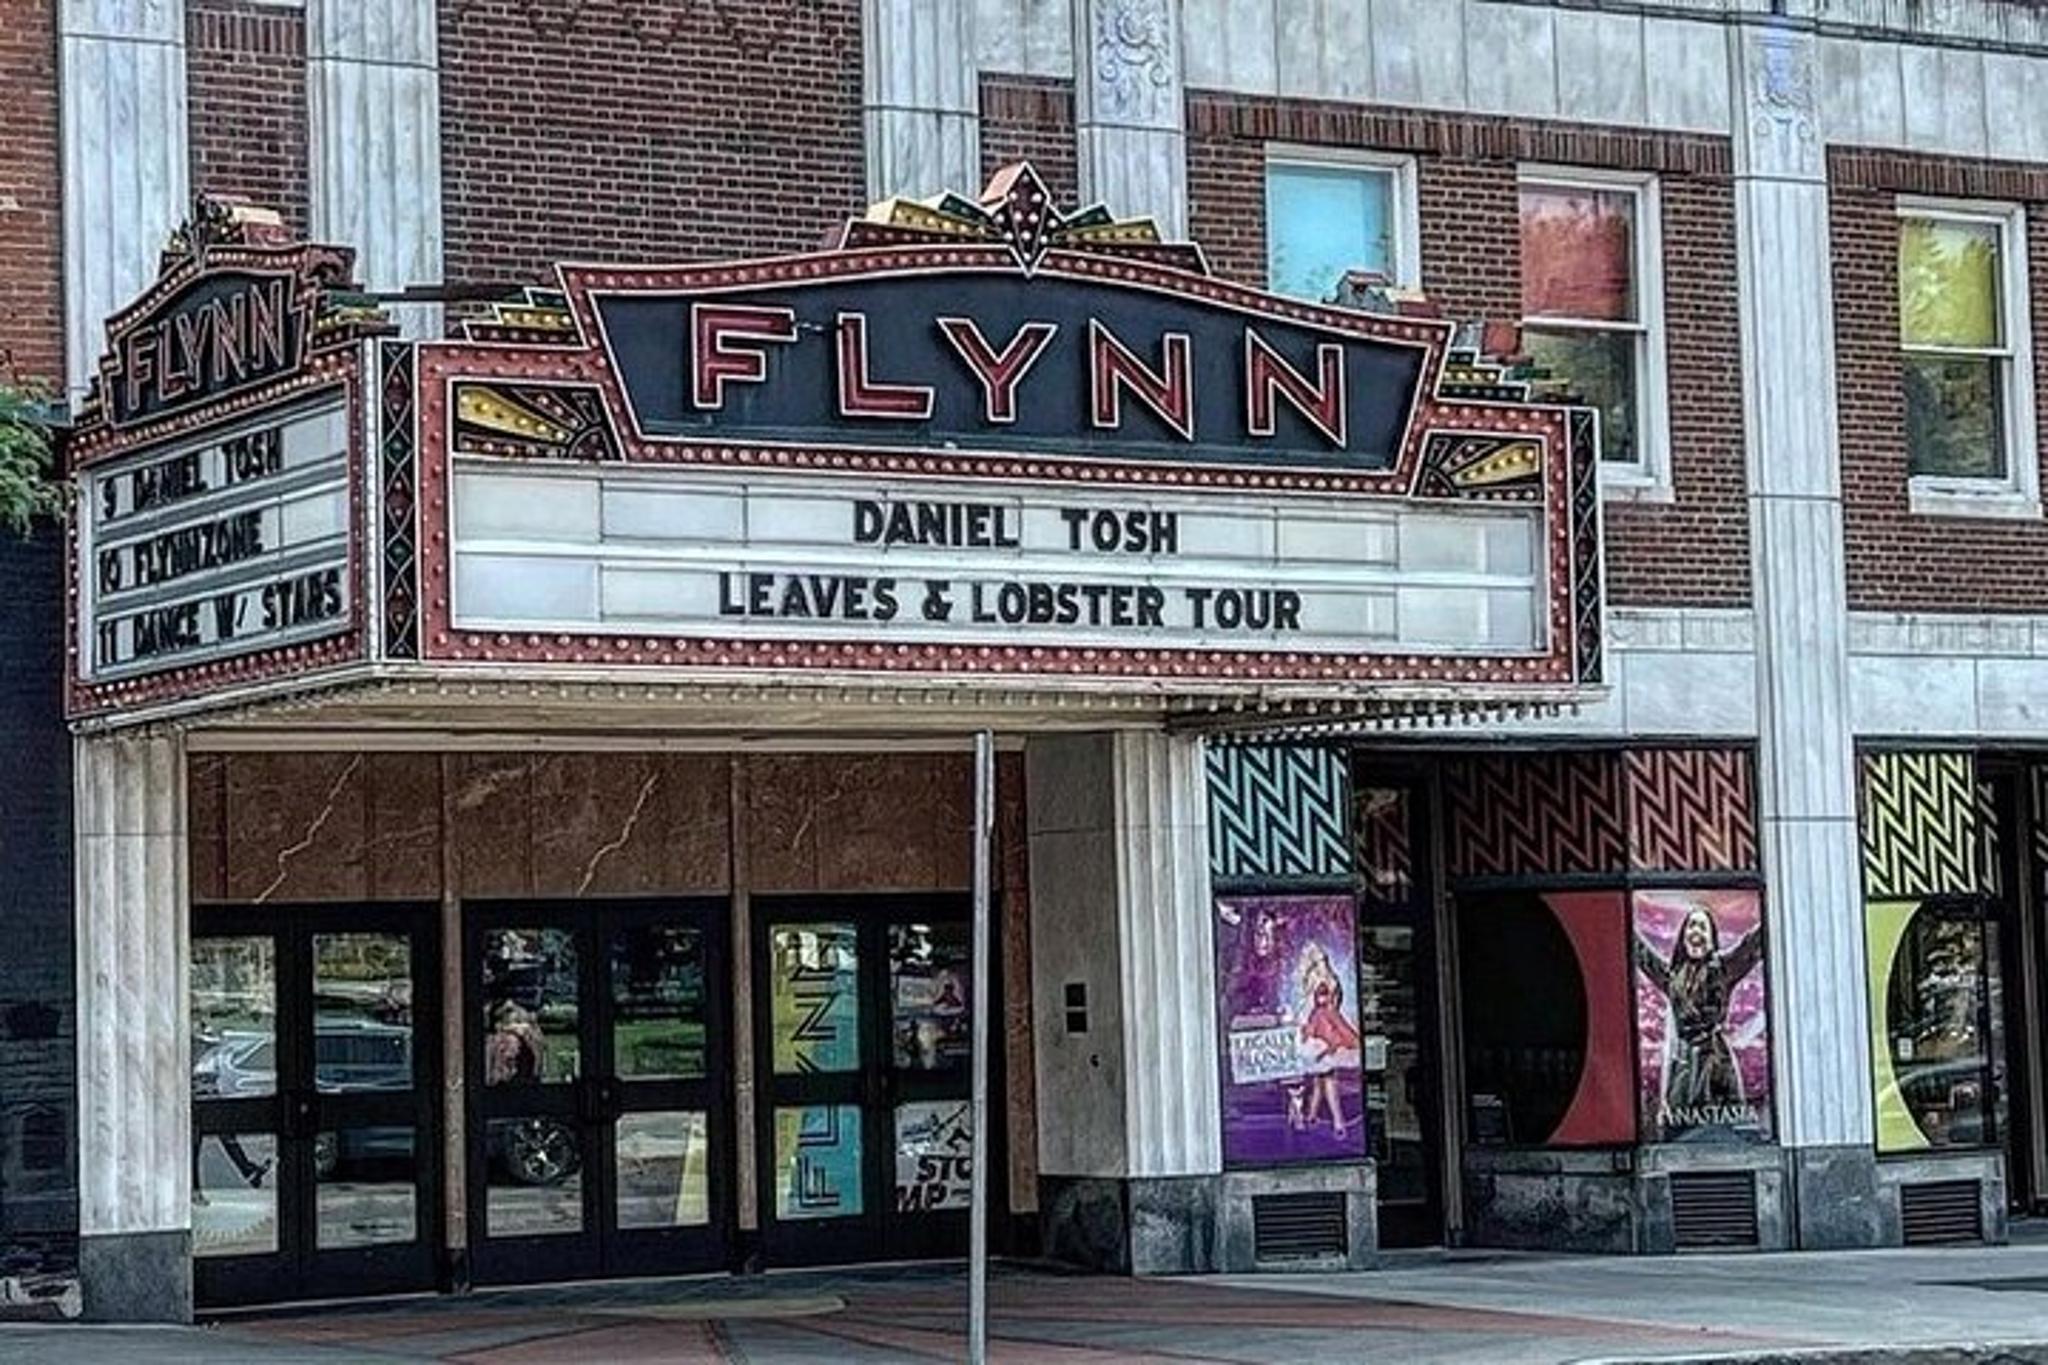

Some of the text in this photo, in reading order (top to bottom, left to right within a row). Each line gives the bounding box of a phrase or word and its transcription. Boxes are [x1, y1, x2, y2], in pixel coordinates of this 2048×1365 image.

[126, 279, 285, 410] FLYNN
[691, 302, 1346, 448] FLYNN
[222, 427, 283, 489] TOSH
[854, 500, 1178, 554] DANIEL TOSH
[262, 567, 342, 628] STARS
[719, 571, 1301, 630] LEAVES & LOBSTER TOUR
[1657, 1104, 1759, 1126] ANASTASIA
